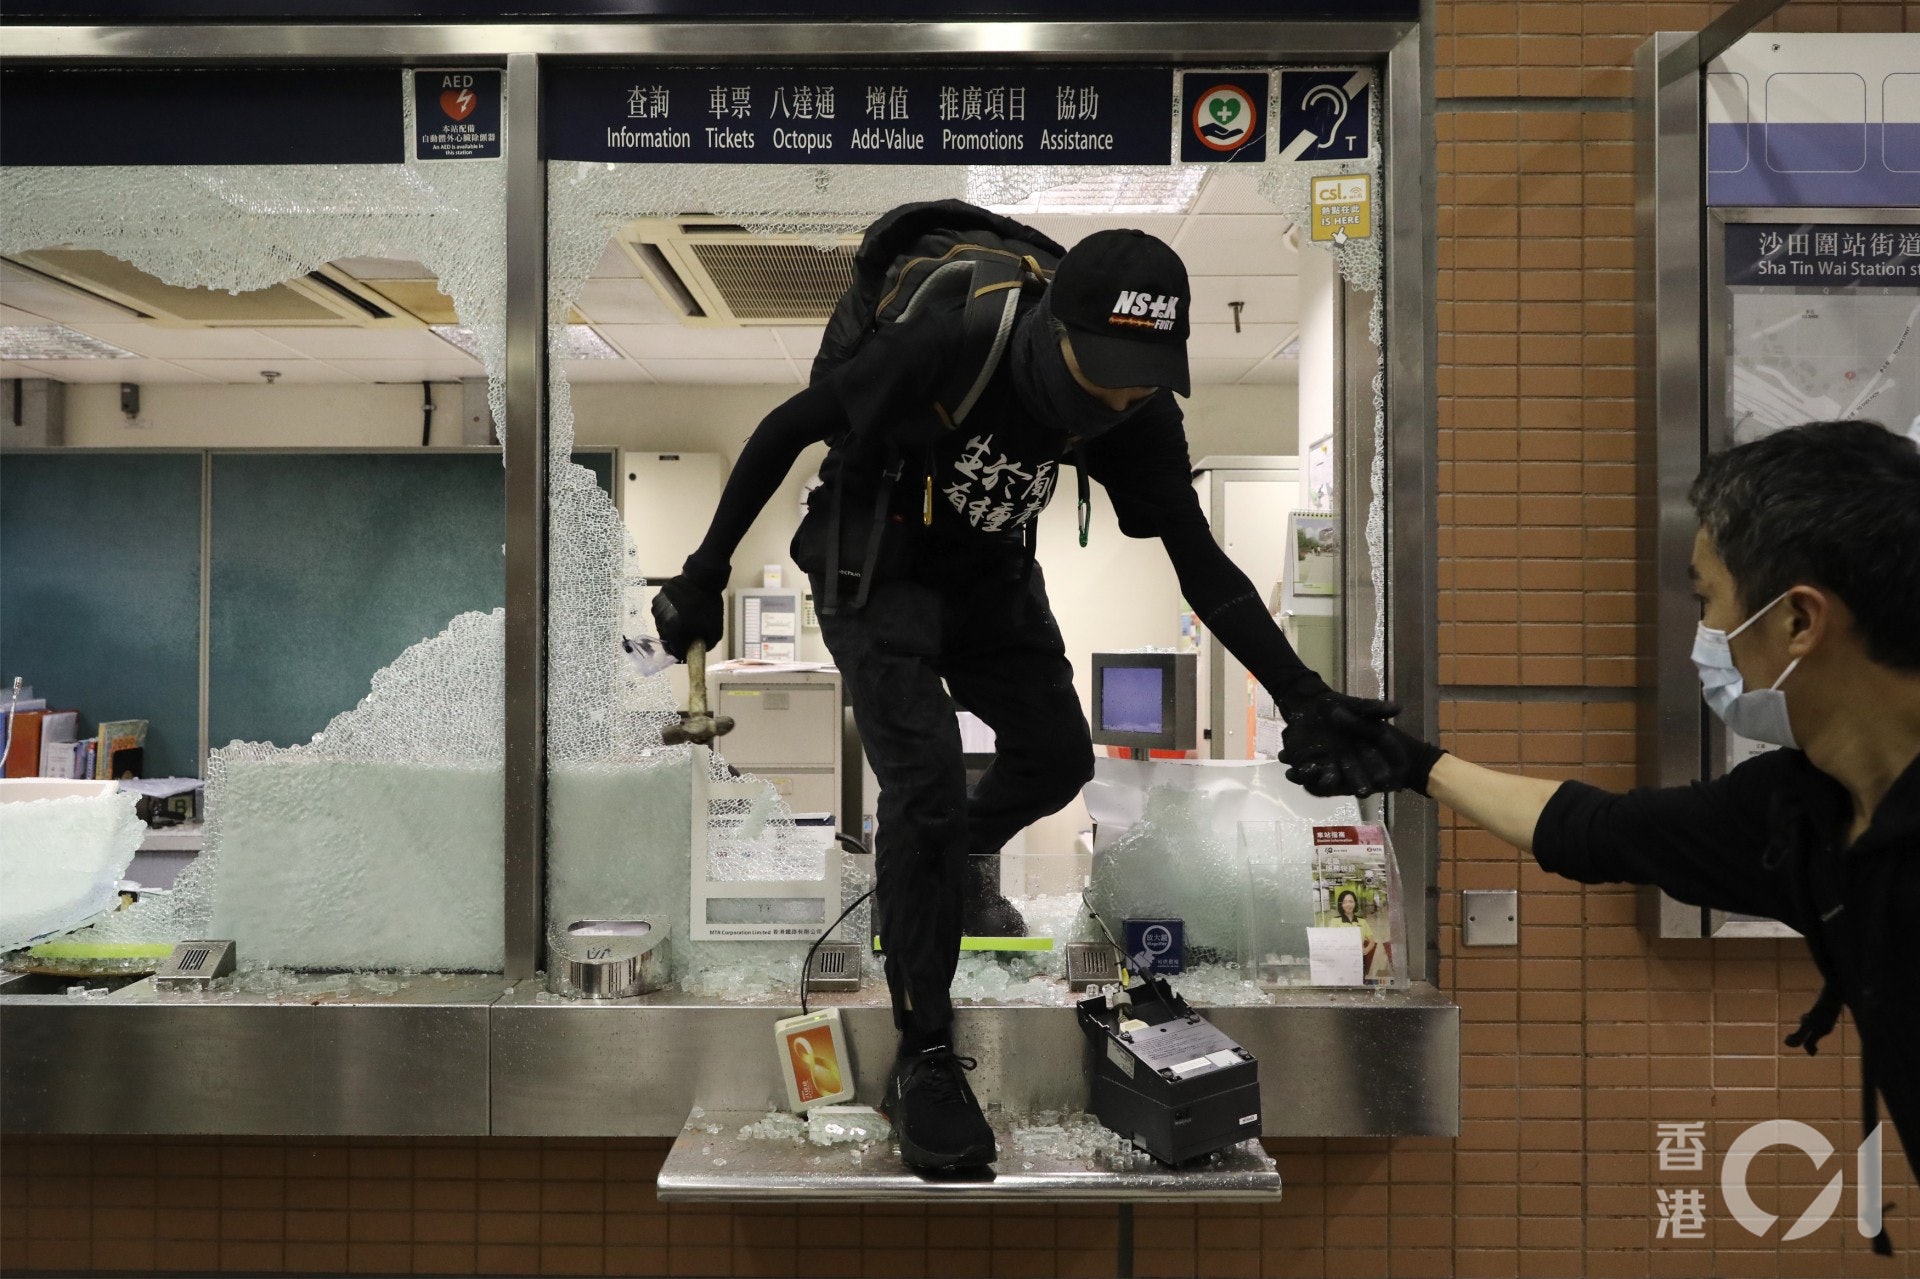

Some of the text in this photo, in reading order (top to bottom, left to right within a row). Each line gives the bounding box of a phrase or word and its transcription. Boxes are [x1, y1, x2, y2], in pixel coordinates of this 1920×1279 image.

[442, 75, 474, 88] AED
[627, 85, 1099, 121] 查詢 車票 八達通 增值 推廣項目 協助
[607, 125, 1114, 154] Information Tickets Octopus Add-Value Promotions Assistance
[1345, 136, 1357, 151] T
[1321, 215, 1360, 226] IS HERE
[1758, 231, 1920, 257] 沙田圍站街道
[1758, 260, 1786, 275] Sha
[1790, 260, 1814, 275] Tin
[1818, 261, 1847, 275] Wai
[1851, 261, 1906, 276] Station
[1153, 319, 1175, 331] FURY
